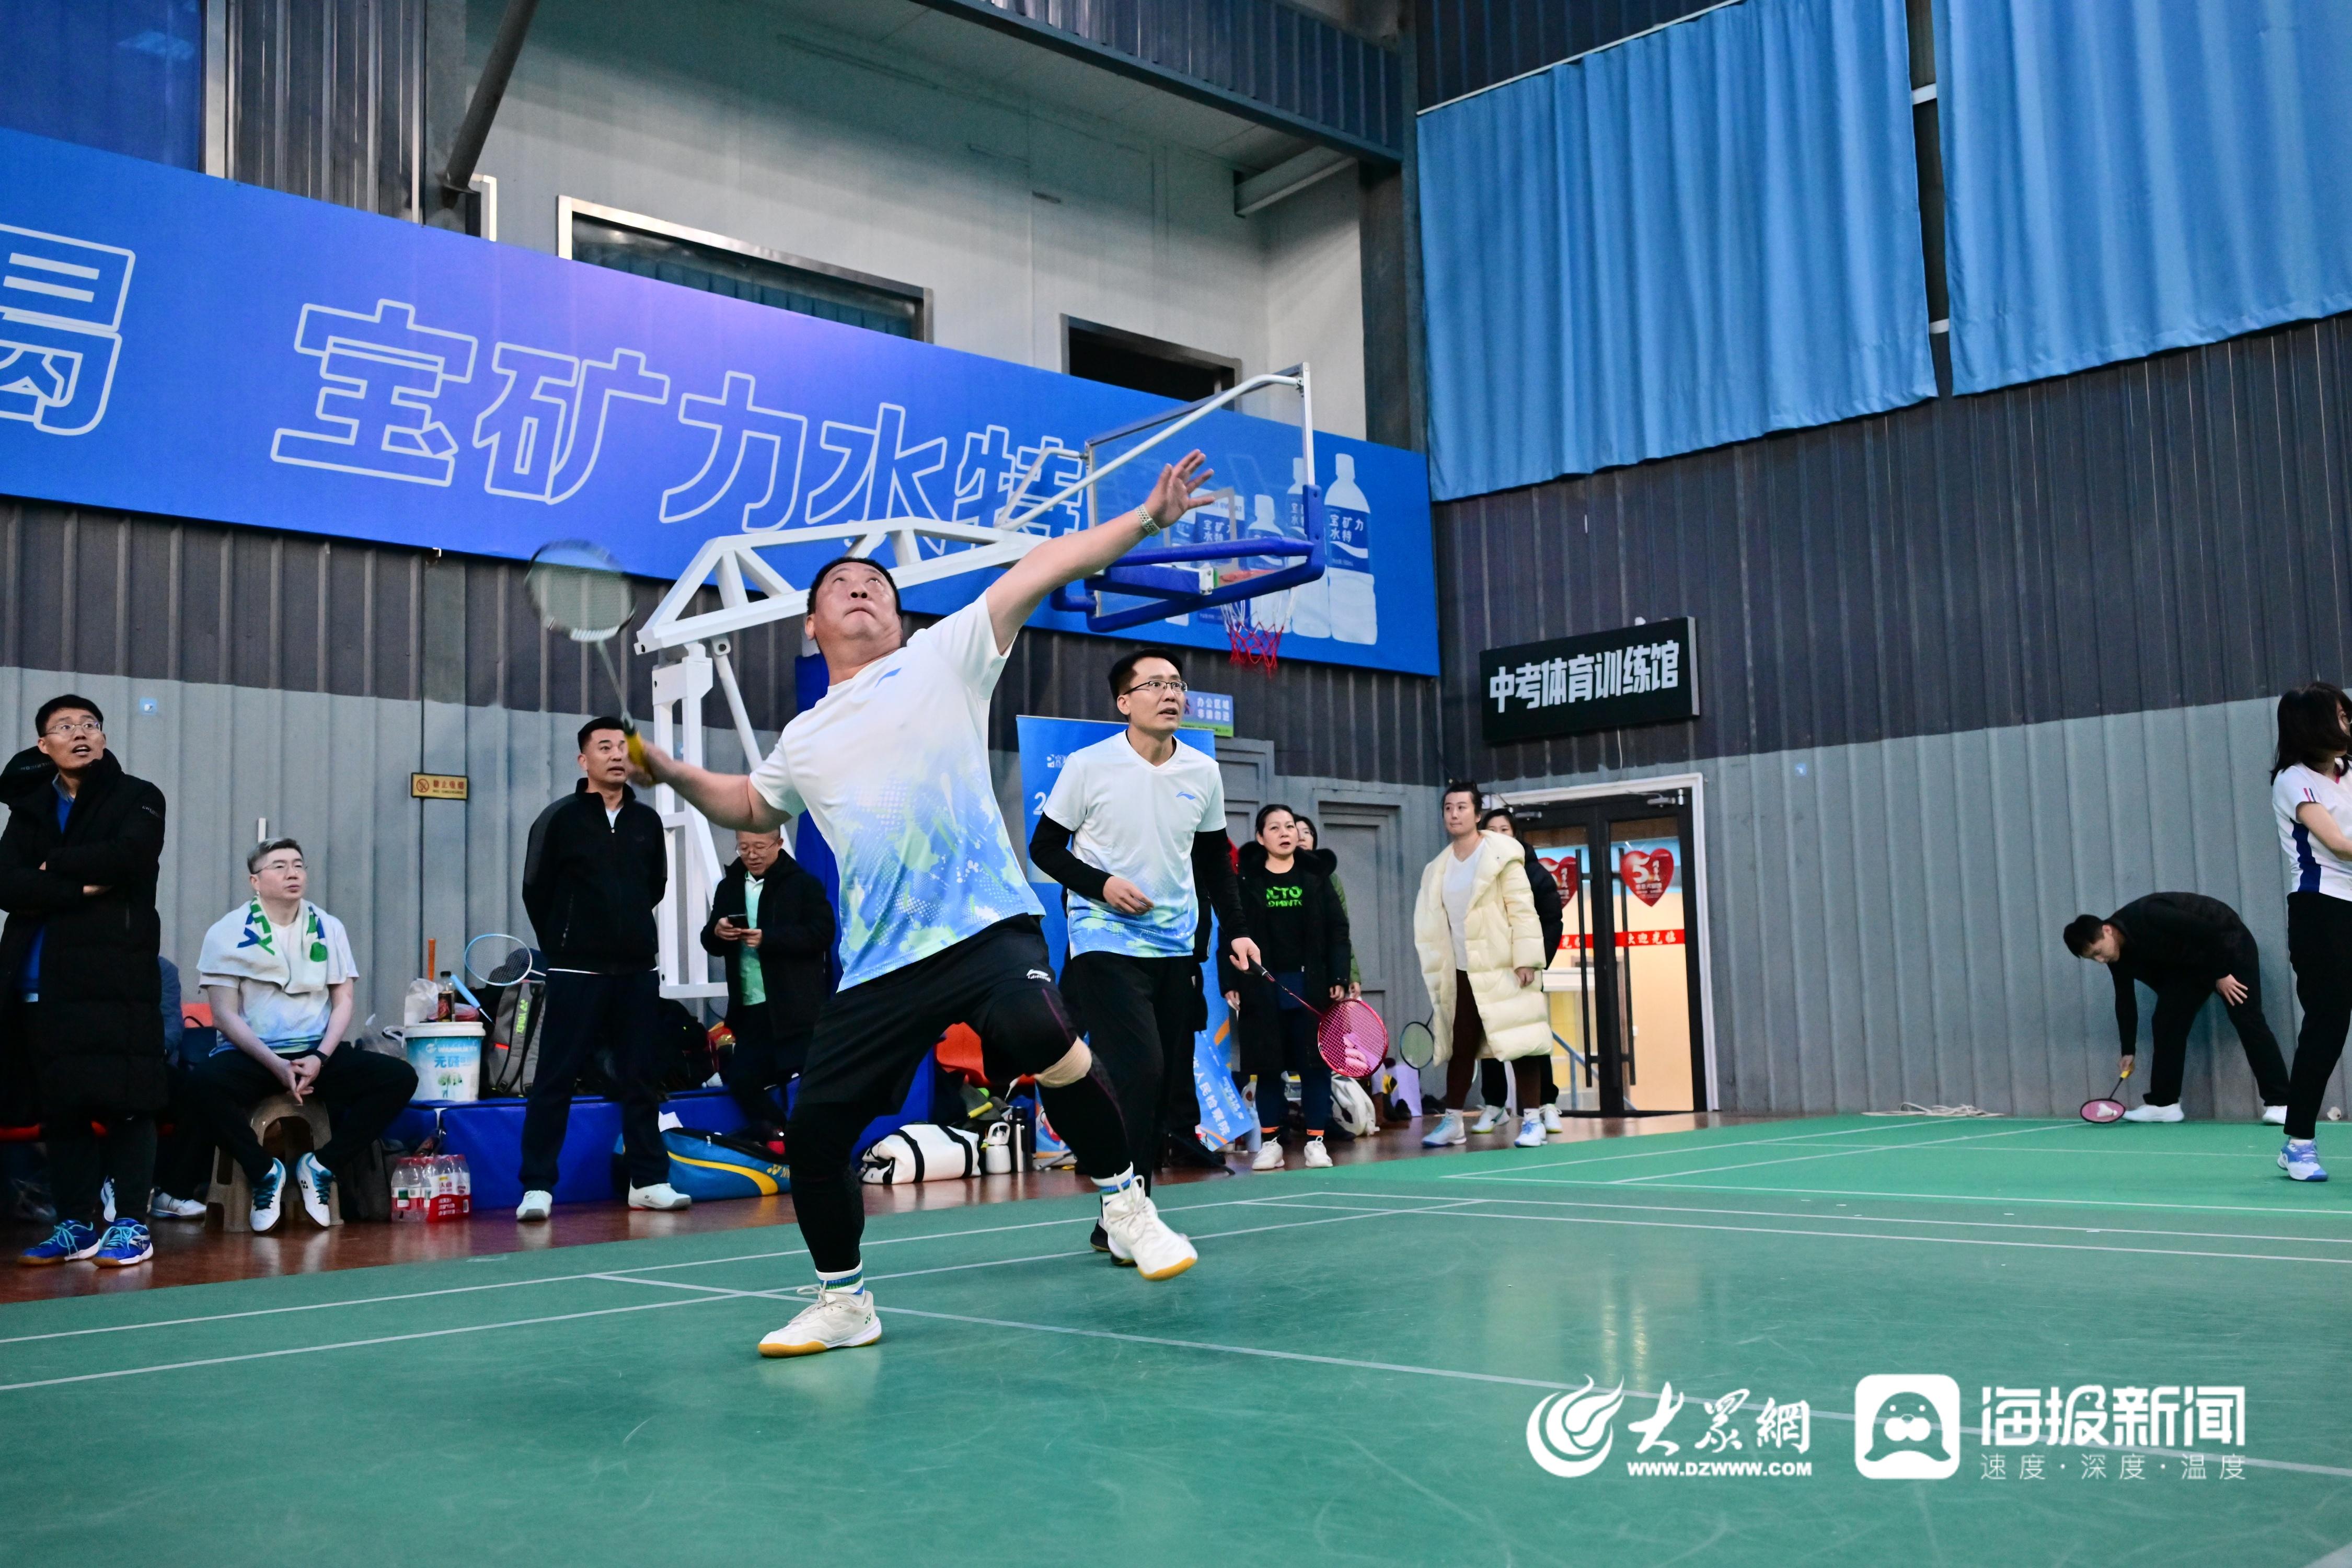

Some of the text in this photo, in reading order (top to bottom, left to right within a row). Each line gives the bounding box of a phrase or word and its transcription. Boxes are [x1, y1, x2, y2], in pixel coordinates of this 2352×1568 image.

[271, 298, 1083, 555] 宝矿力水特
[1329, 514, 1364, 531] 宝矿力
[1330, 527, 1352, 543] 水特
[1490, 640, 1679, 713] 中考体育训练馆
